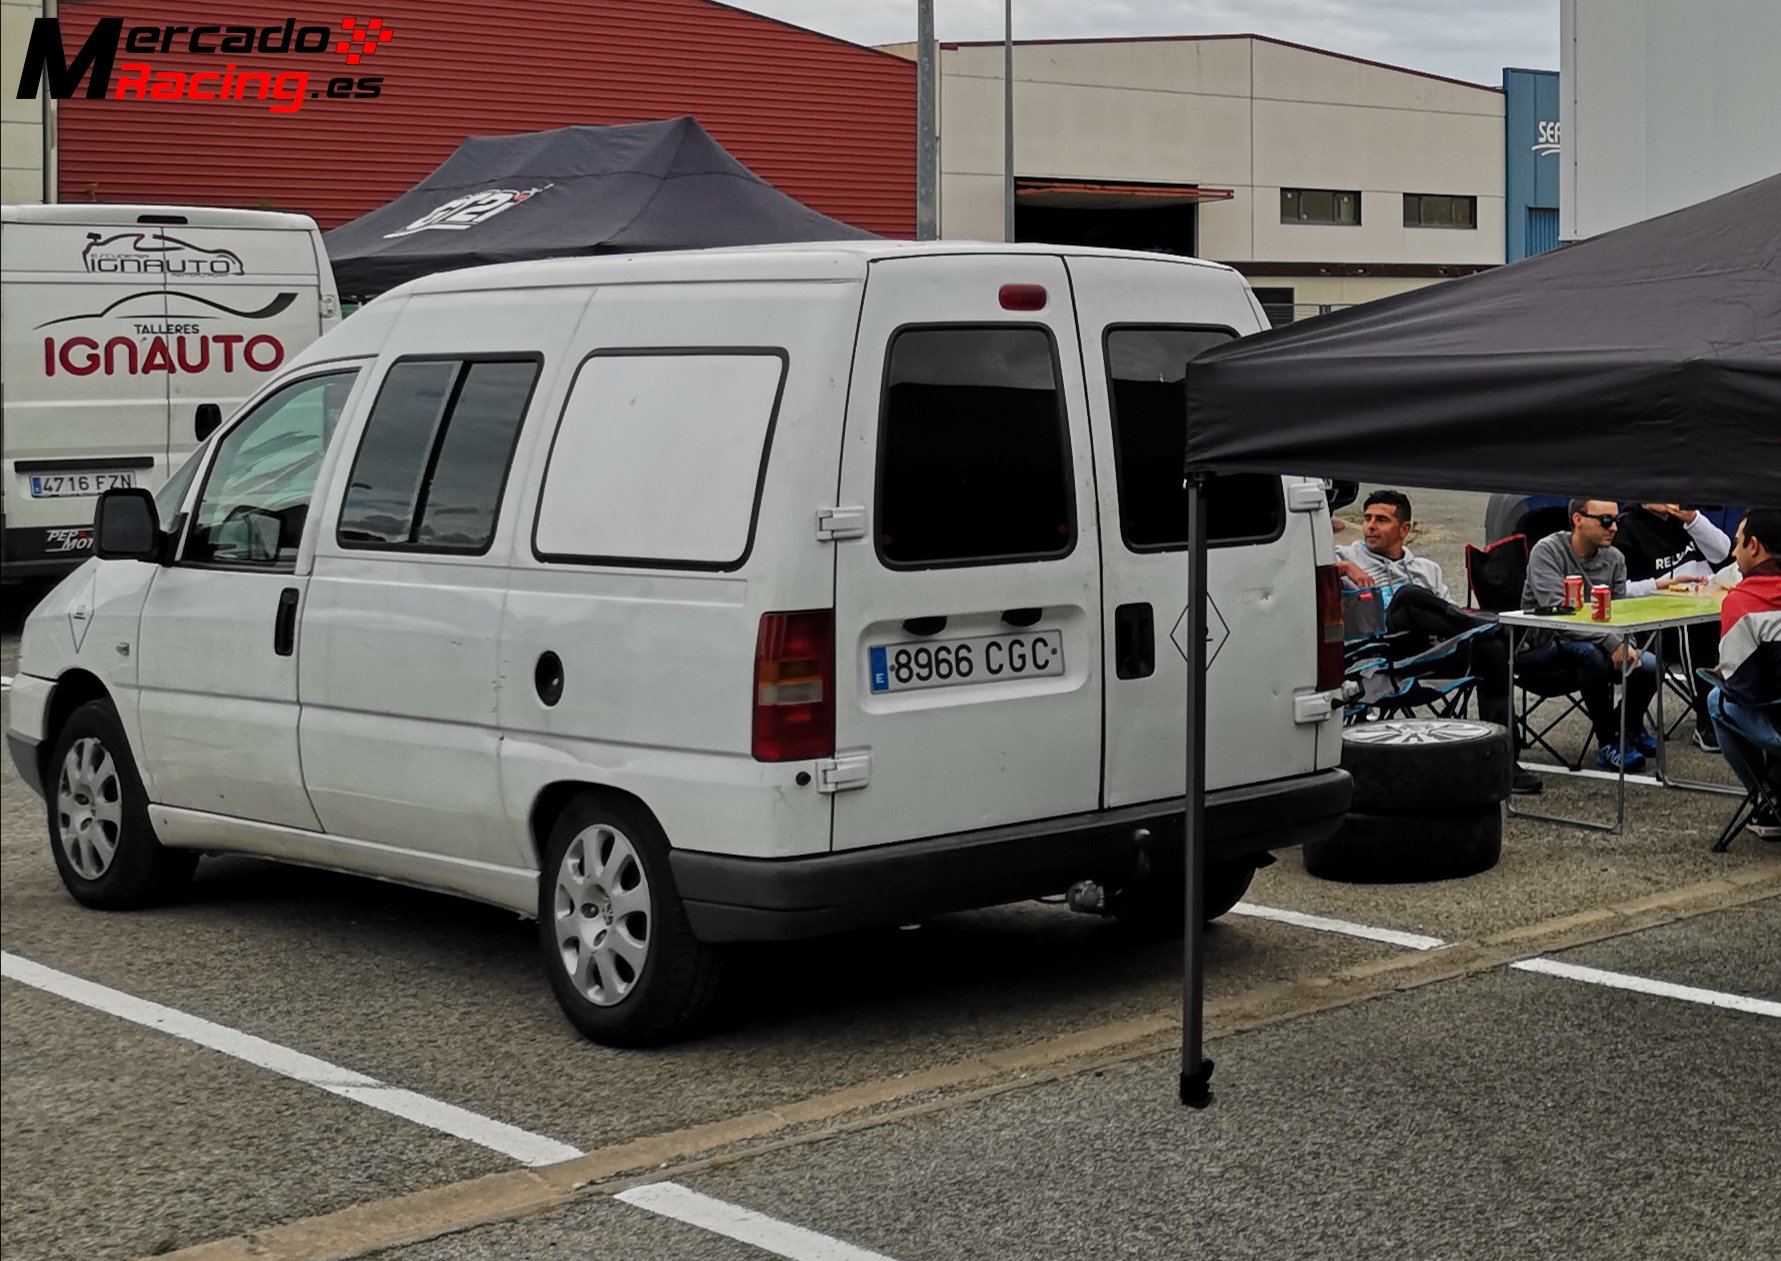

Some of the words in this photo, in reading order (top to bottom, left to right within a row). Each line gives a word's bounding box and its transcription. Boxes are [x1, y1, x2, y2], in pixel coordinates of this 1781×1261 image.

[91, 259, 230, 273] IGNAUTO
[134, 324, 200, 335] TALLERES
[44, 334, 285, 377] IGNAUTO
[43, 476, 90, 492] 4716
[96, 474, 132, 489] FZN
[47, 529, 79, 542] PEP
[894, 643, 974, 683] 8966
[985, 637, 1050, 675] CGC
[875, 673, 884, 684] E
